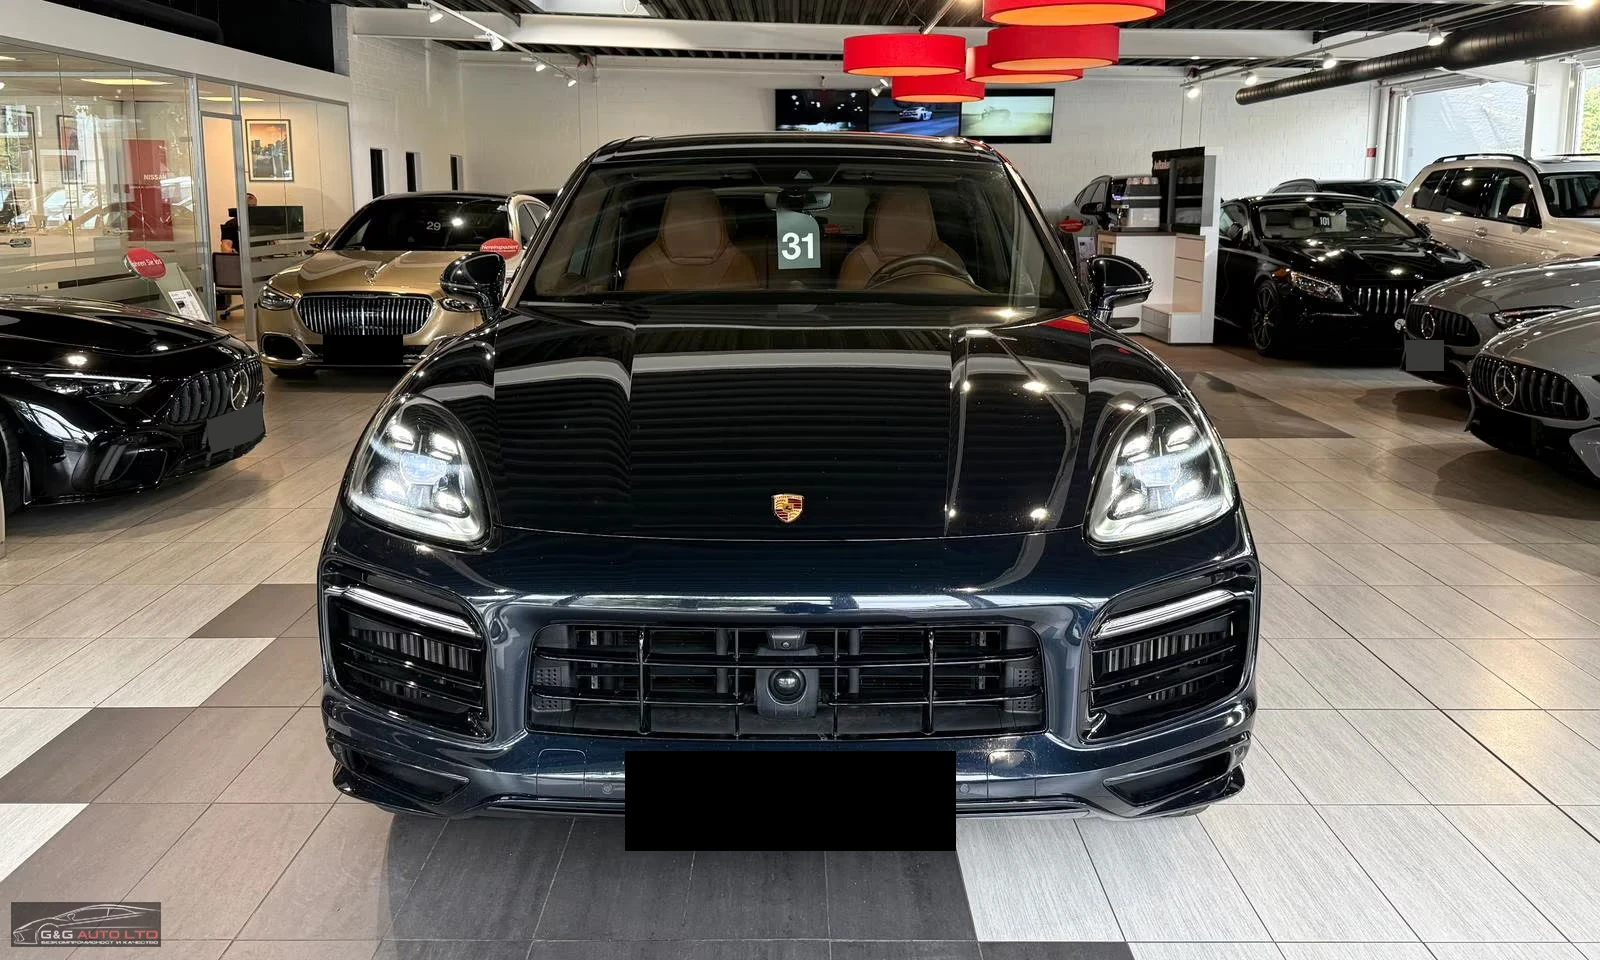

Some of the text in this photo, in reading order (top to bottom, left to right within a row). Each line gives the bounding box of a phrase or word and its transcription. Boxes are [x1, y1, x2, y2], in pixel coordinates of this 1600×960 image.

[426, 221, 441, 231] 29
[1319, 216, 1330, 226] 101
[781, 232, 814, 260] 31
